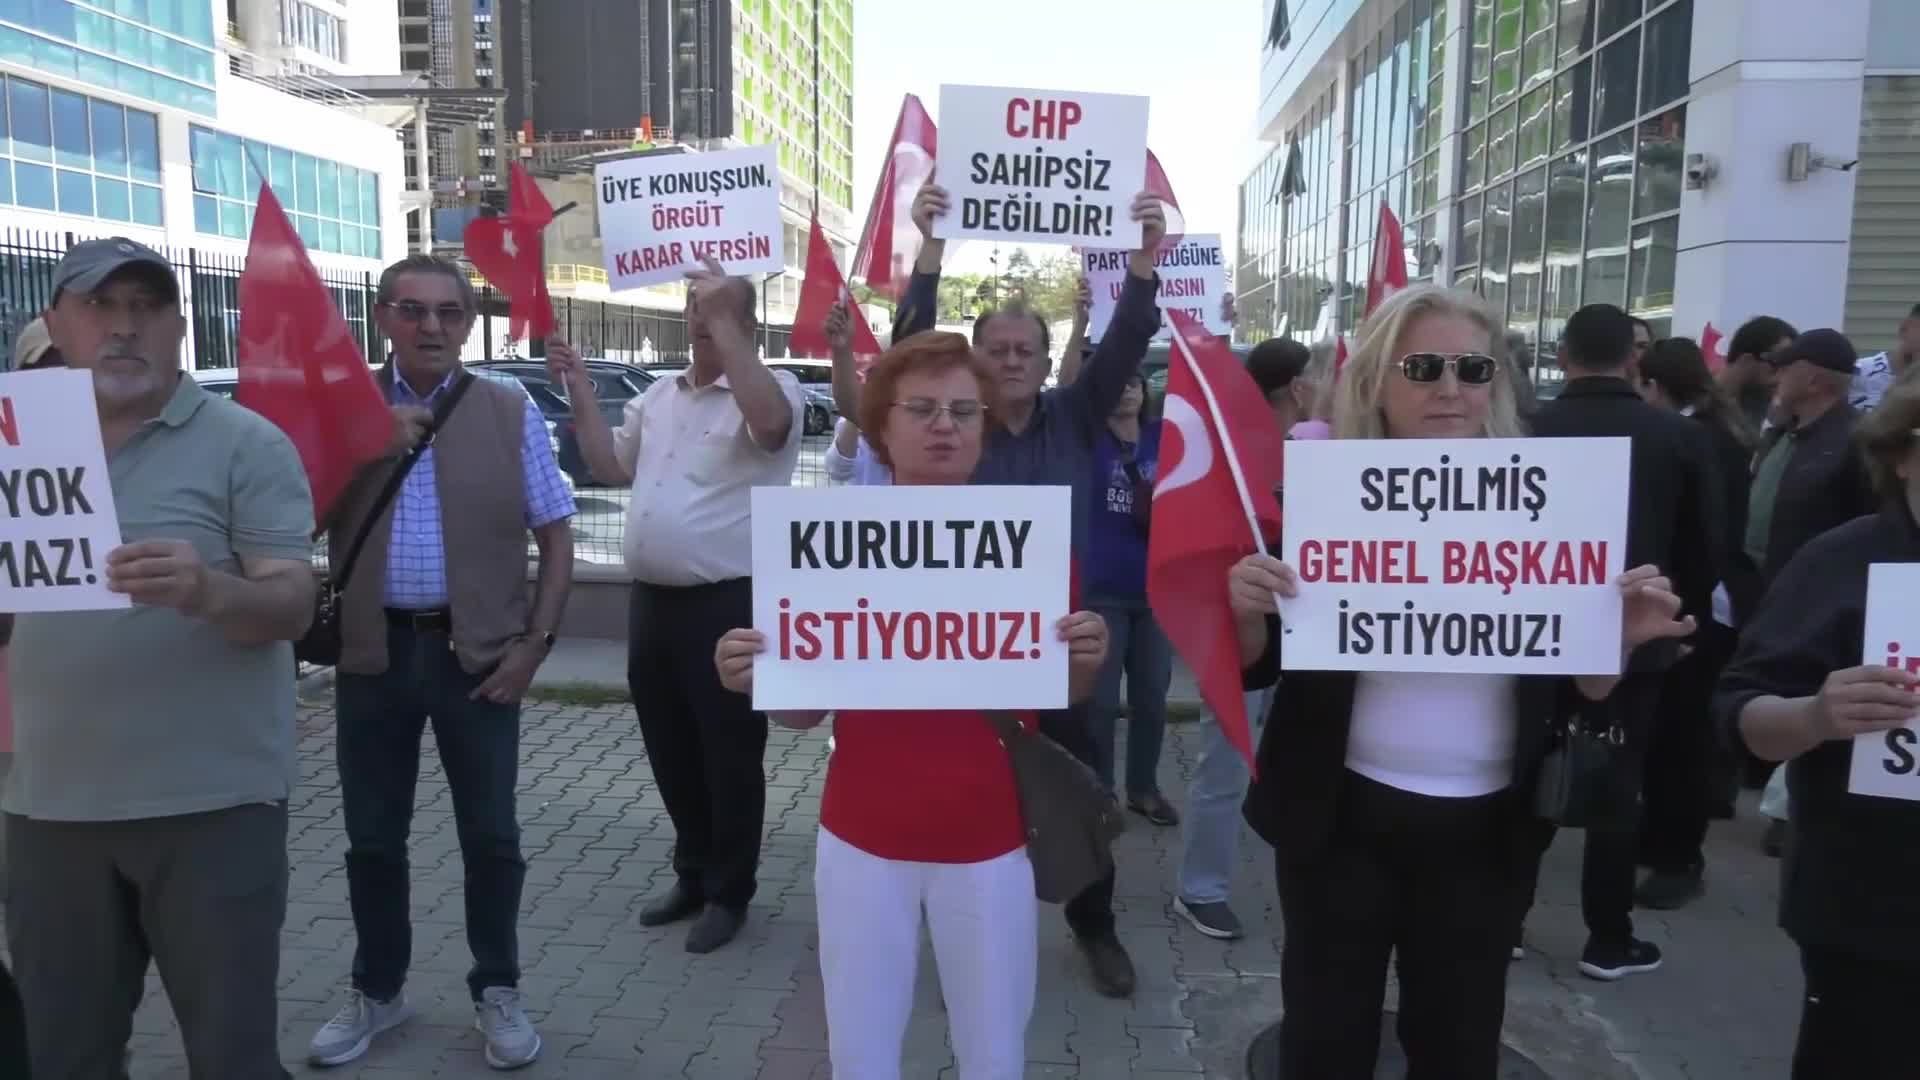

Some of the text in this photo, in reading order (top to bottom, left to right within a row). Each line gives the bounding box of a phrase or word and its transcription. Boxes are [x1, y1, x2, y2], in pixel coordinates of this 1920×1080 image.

[1006, 97, 1082, 140] CHP
[602, 164, 772, 204] ÜYE KONUŞSUN,
[970, 146, 1111, 192] SAHİPSİZ
[652, 200, 724, 231] ÖRGÜT
[962, 191, 1114, 237] DEĞİLDİR!
[615, 231, 771, 277] KARAR VERSİN
[0, 467, 94, 518] YOK
[1360, 453, 1548, 523] SEÇİLMİŞ
[789, 519, 1033, 570] KURULTAY
[1299, 539, 1609, 596] GENEL BAŞKAN
[778, 597, 1041, 661] İSTİYORUZ!
[1338, 599, 1562, 658] İSTİYORUZ!
